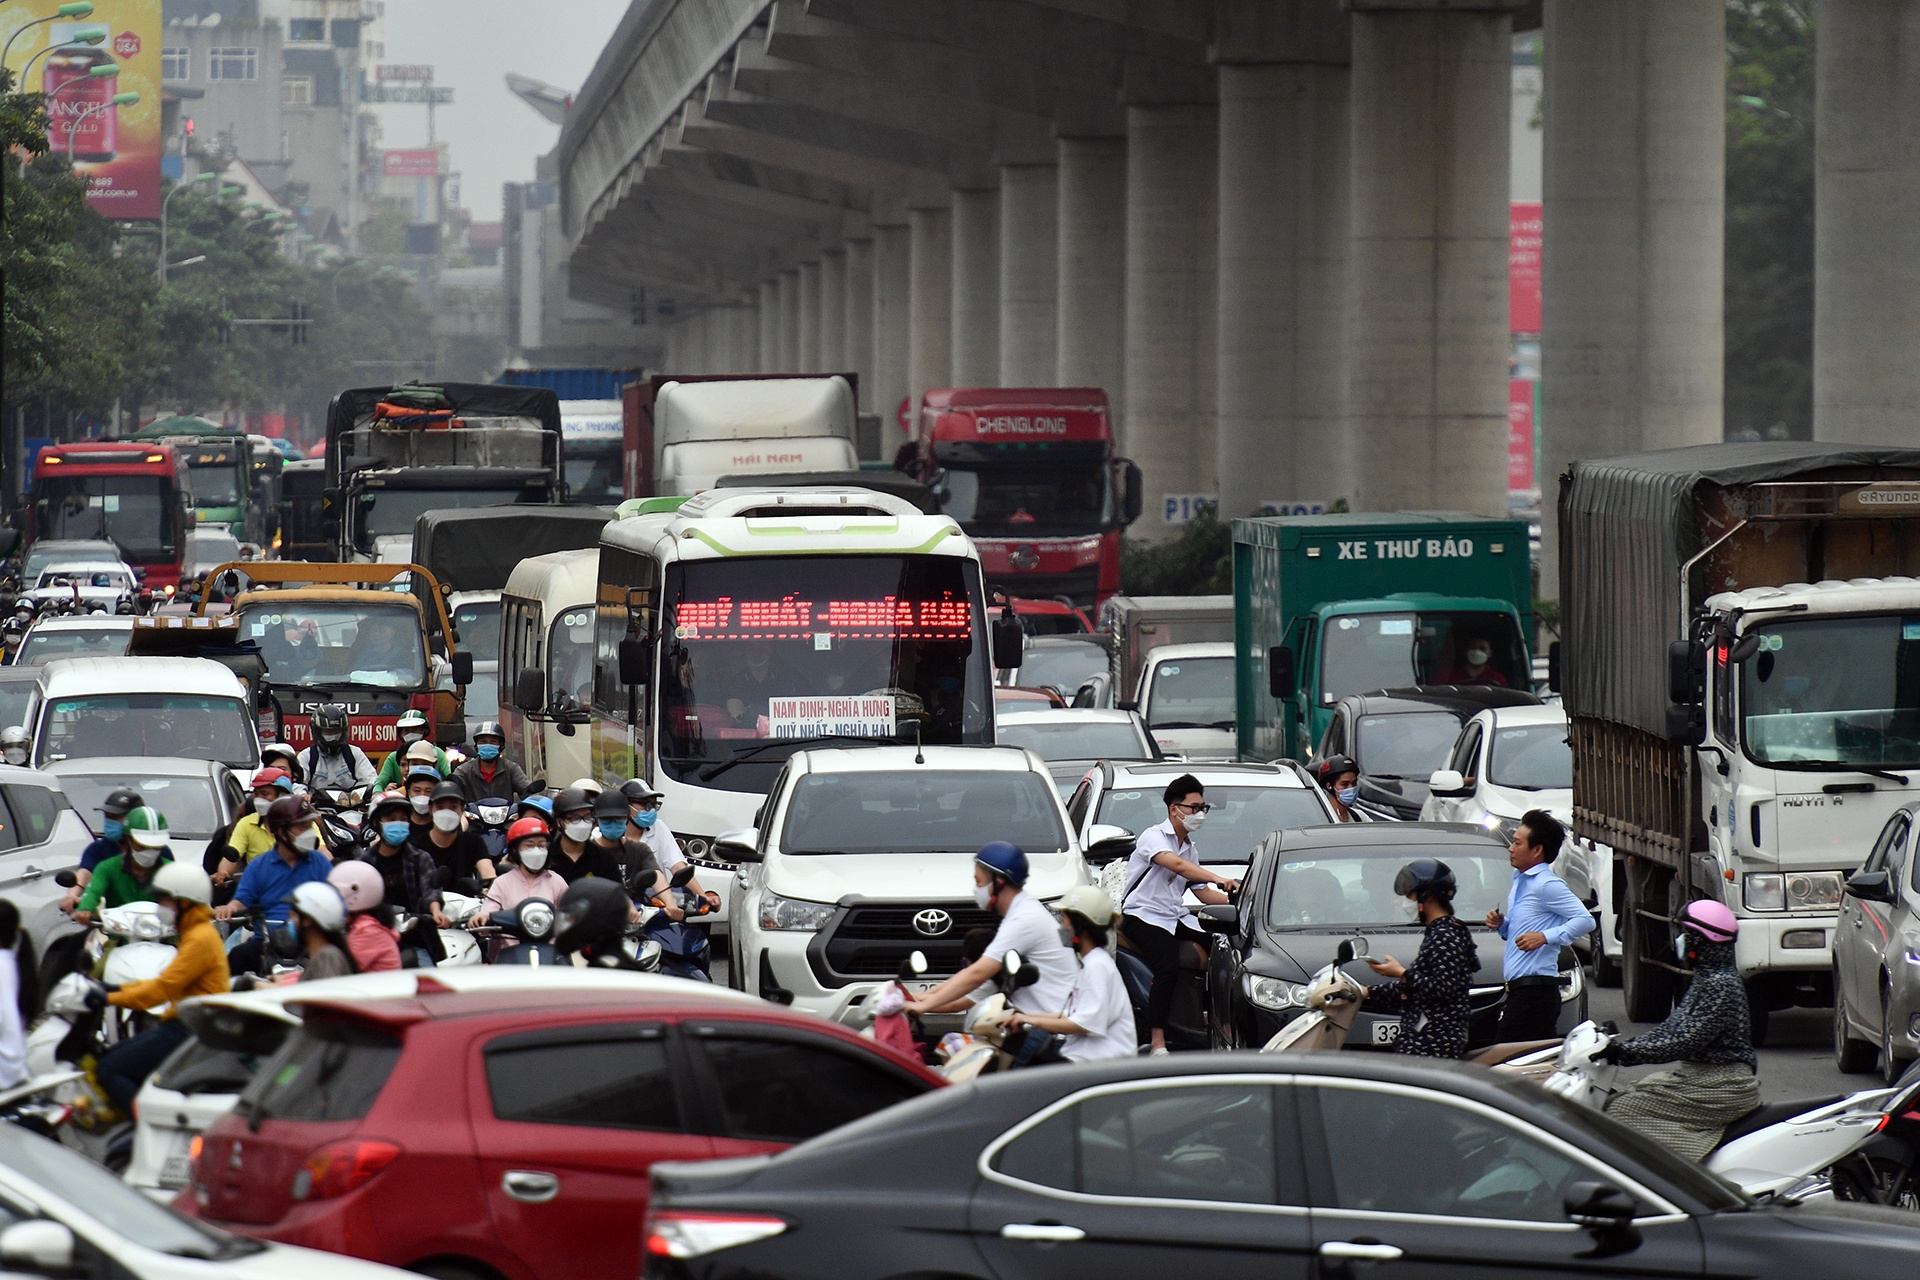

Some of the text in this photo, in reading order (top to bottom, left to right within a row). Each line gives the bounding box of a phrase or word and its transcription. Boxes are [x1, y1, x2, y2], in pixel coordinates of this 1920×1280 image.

[117, 43, 138, 52] USA
[61, 121, 98, 133] GOLD
[976, 416, 1067, 433] CHENGLONG
[766, 453, 803, 463] NAM
[1337, 535, 1474, 560] XE THƯ BÁO
[773, 701, 797, 718] NAM
[862, 699, 890, 717] HƯNG
[294, 724, 306, 740] TY
[351, 721, 397, 741] PHÚ SƠN
[775, 721, 797, 738] QUỸ
[799, 719, 828, 738] NHẤT
[835, 720, 869, 736] NGHĨA
